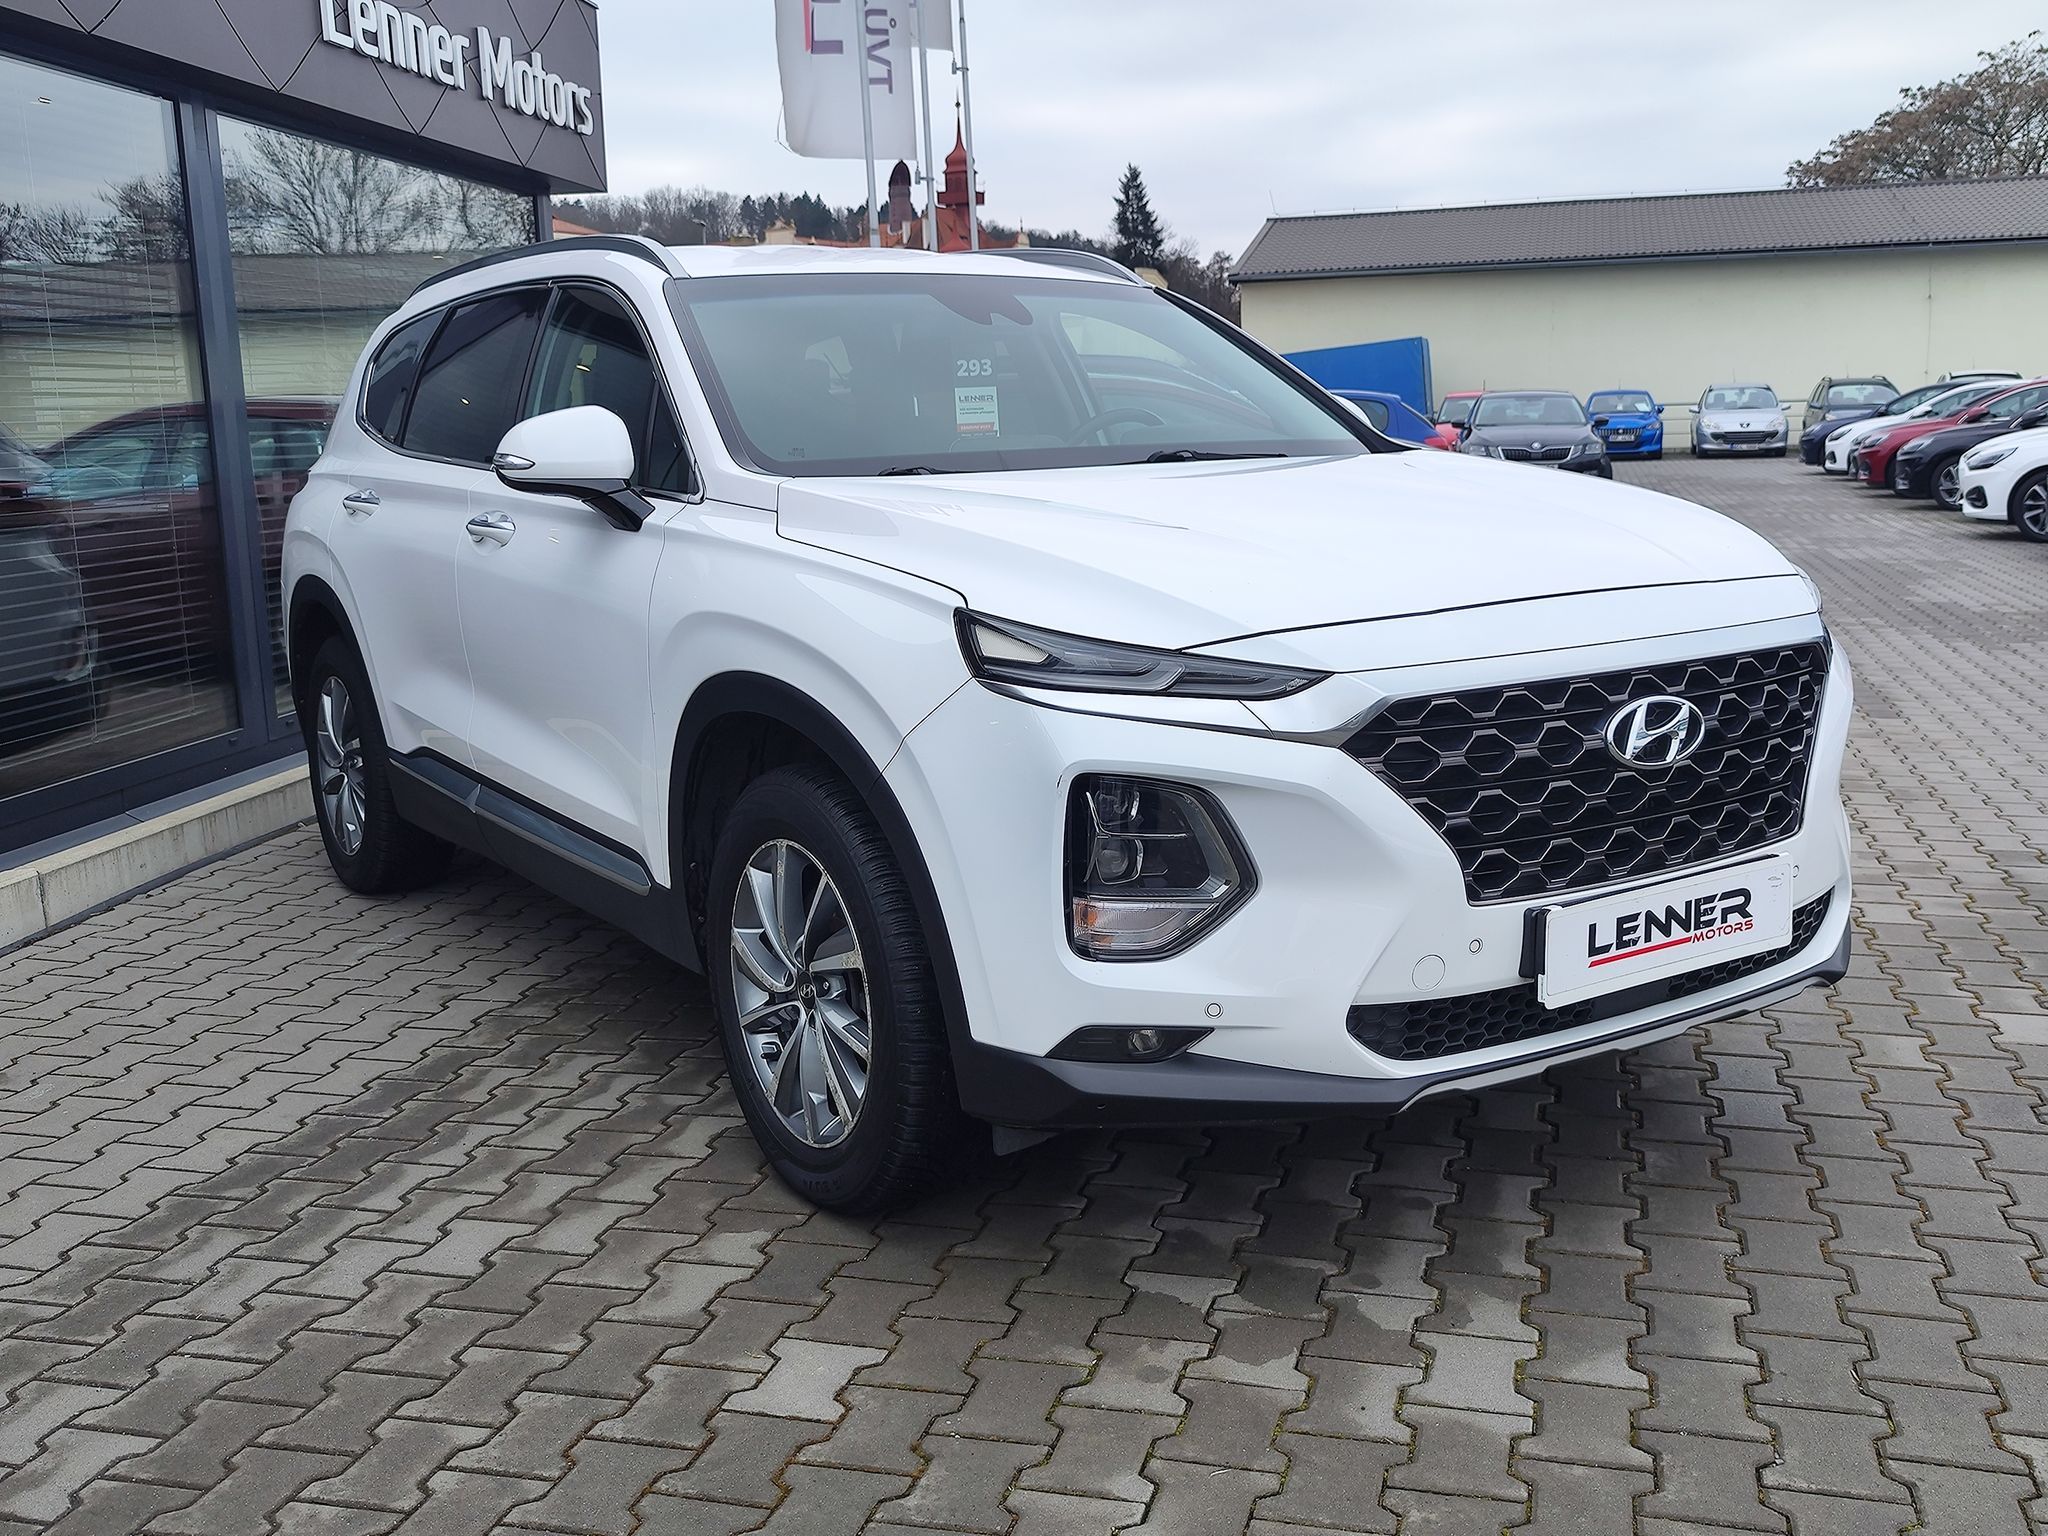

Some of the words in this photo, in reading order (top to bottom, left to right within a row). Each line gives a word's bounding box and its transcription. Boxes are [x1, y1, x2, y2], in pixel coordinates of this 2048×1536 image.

[319, 0, 470, 91] Lenner
[476, 26, 594, 136] Motors
[956, 359, 993, 377] 293
[1588, 887, 1753, 958] LENNER
[1692, 918, 1754, 944] MOTORS
